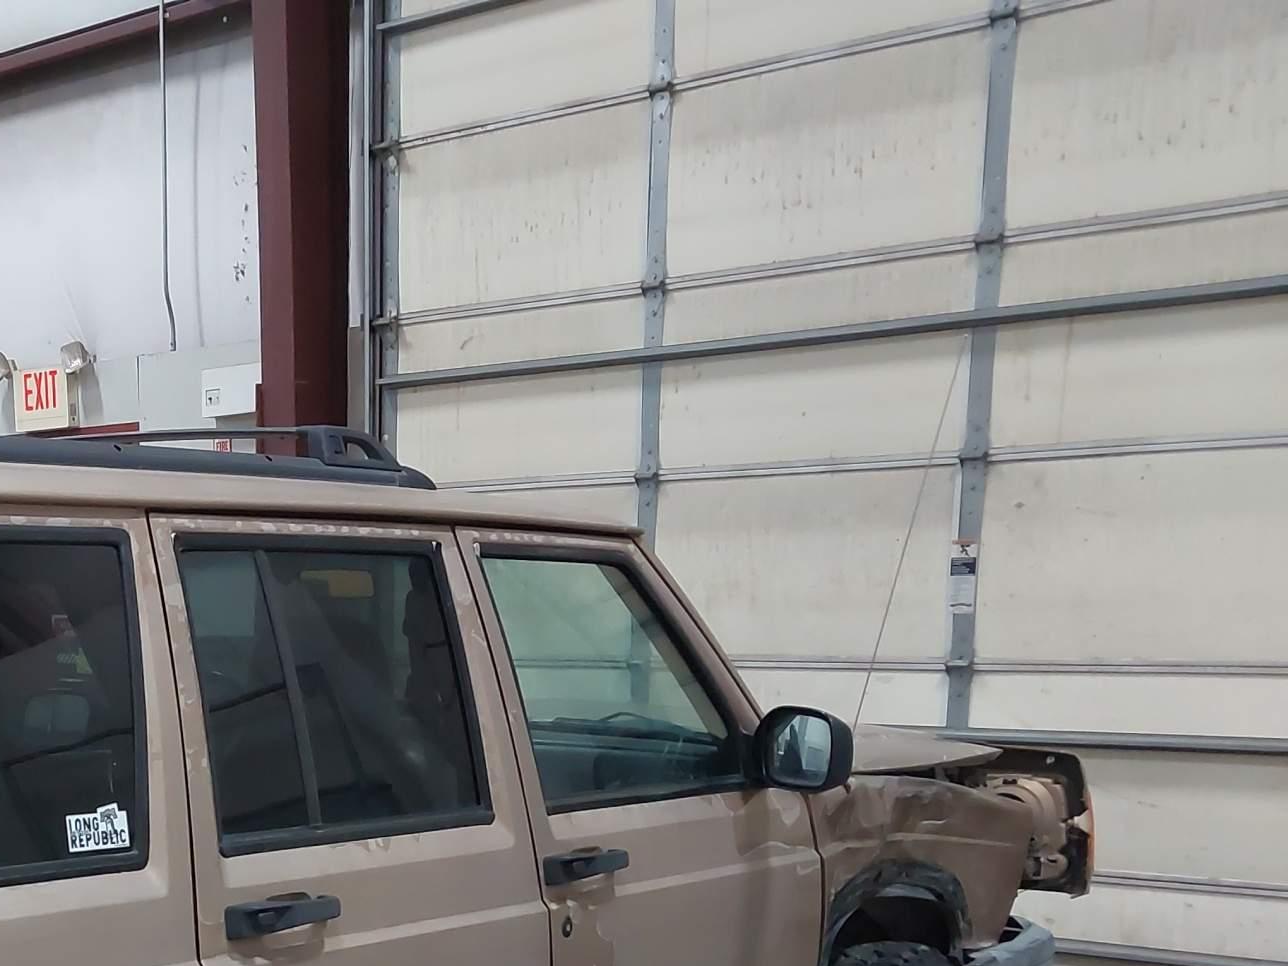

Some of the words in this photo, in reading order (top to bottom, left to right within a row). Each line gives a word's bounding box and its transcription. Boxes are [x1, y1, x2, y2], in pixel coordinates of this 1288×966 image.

[23, 369, 58, 412] EXIT
[215, 440, 229, 452] FIRE
[68, 816, 100, 834] LONG
[70, 828, 127, 849] REPUBLIC
